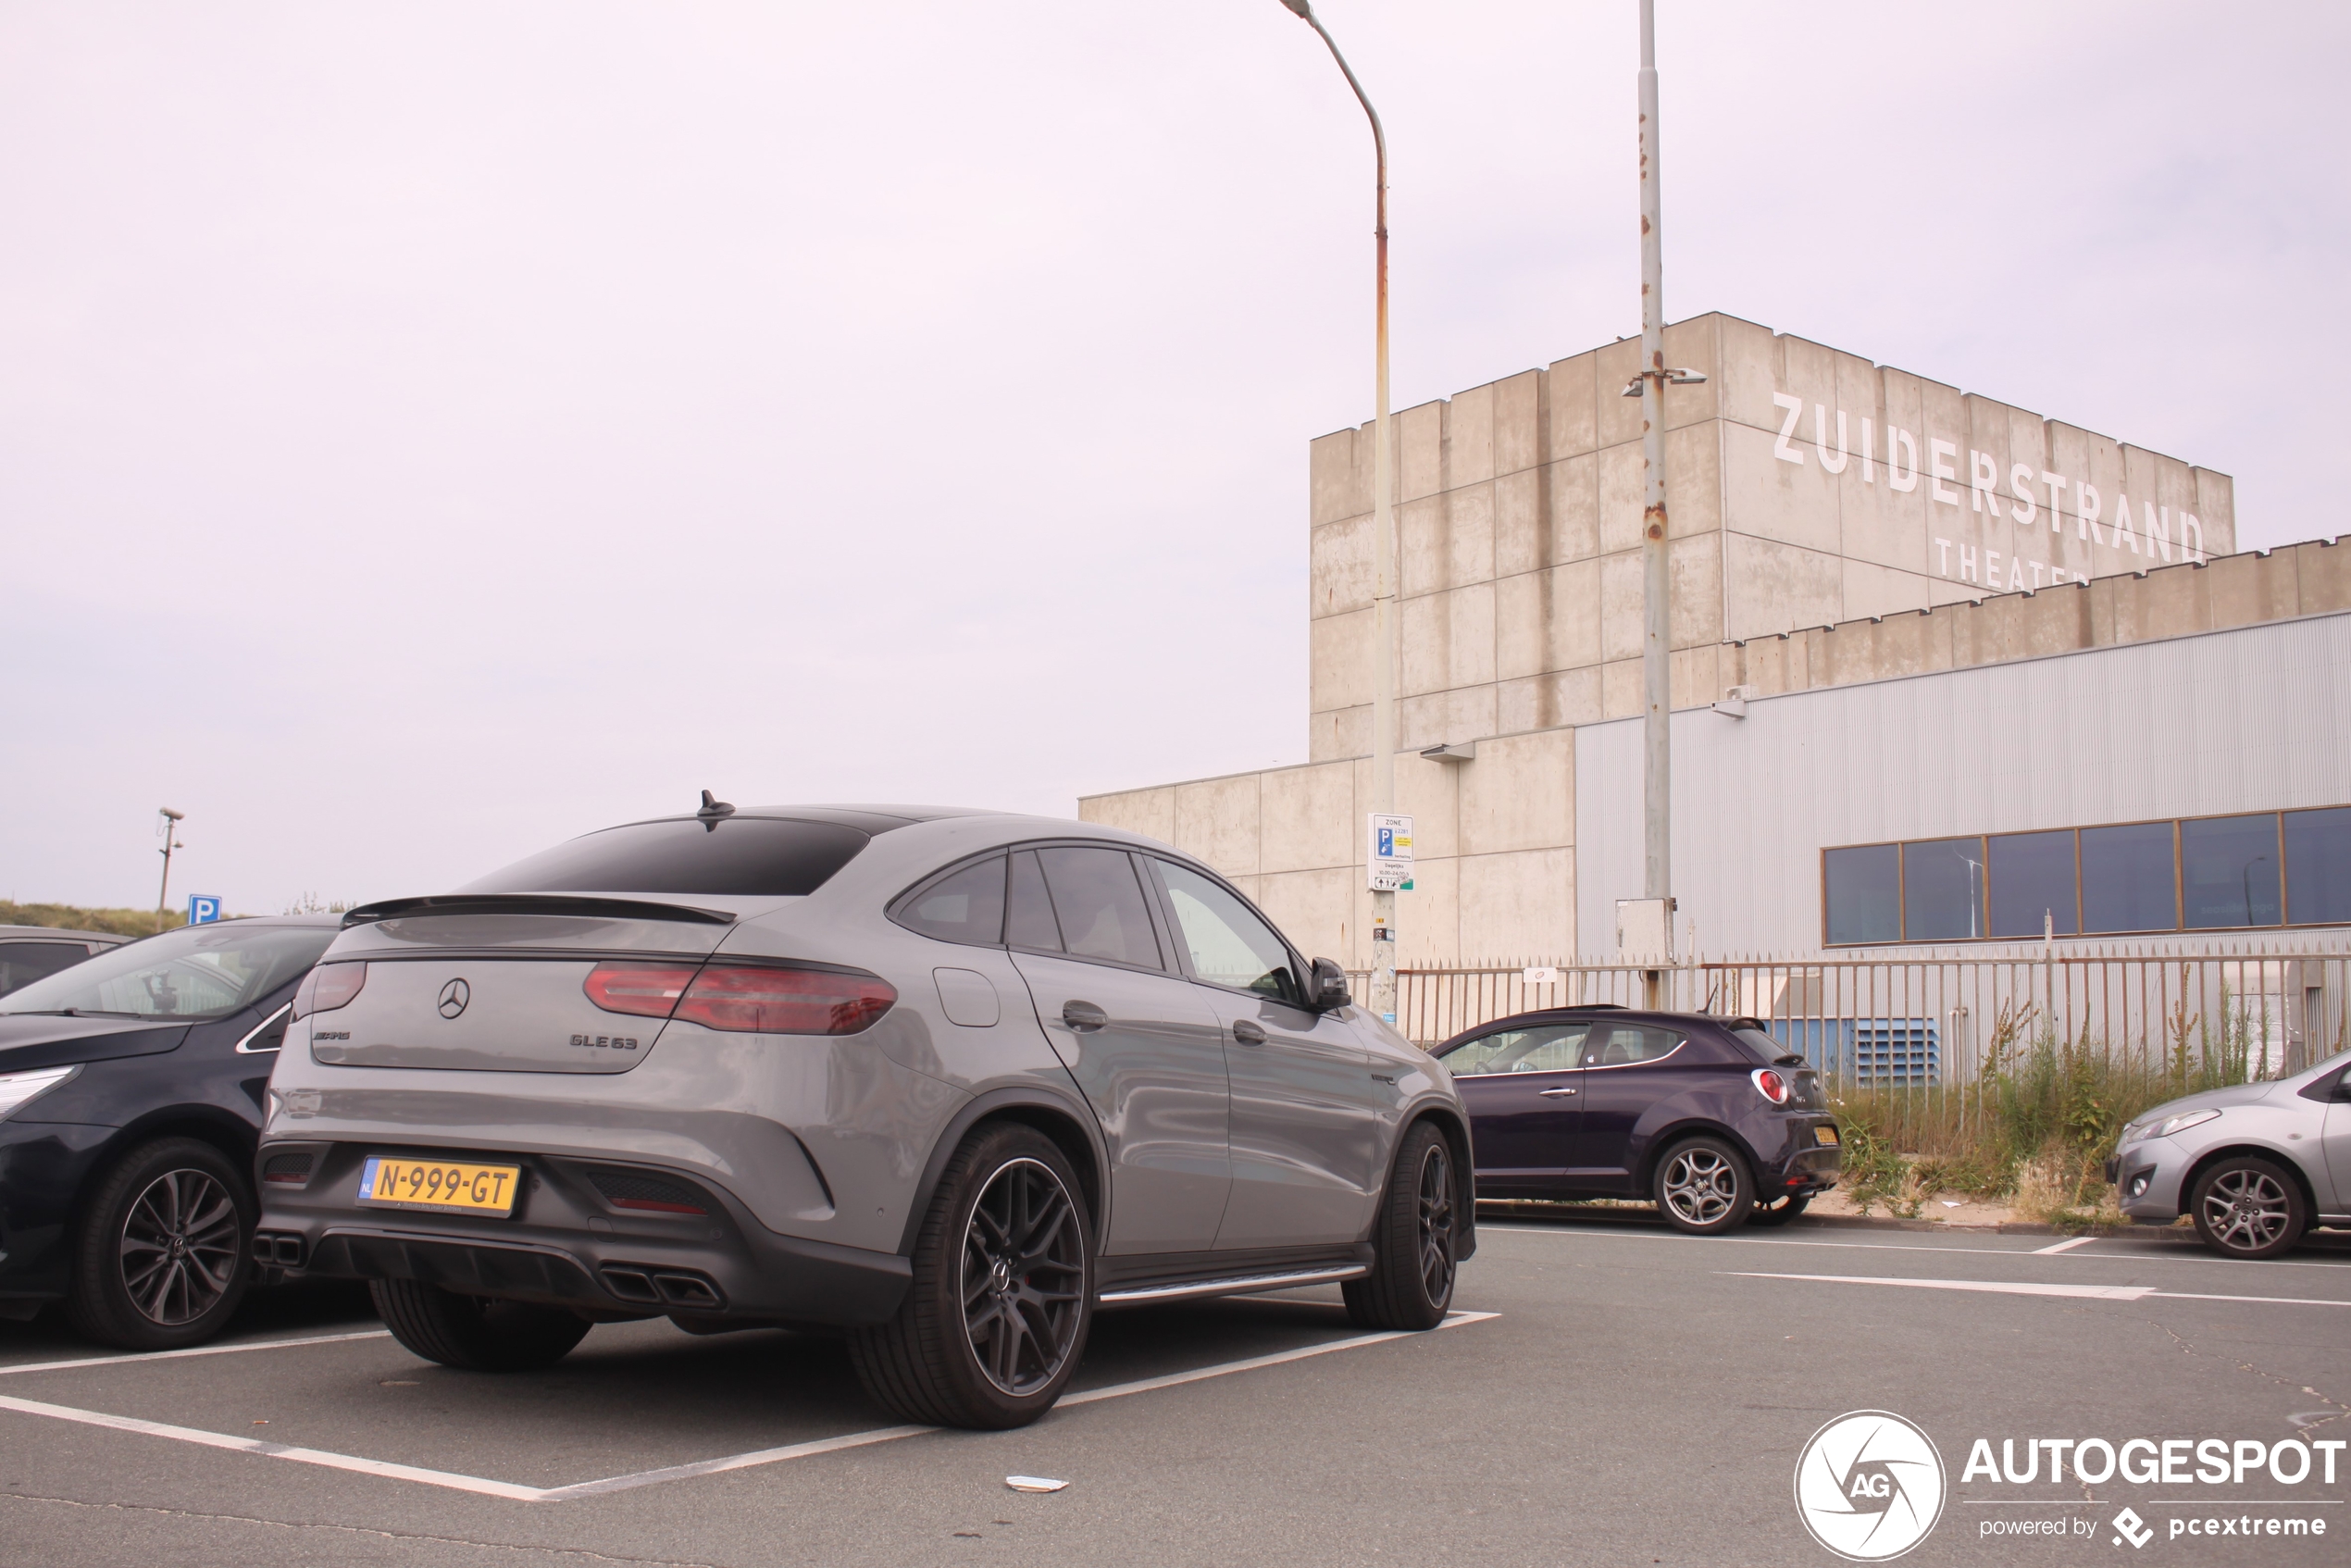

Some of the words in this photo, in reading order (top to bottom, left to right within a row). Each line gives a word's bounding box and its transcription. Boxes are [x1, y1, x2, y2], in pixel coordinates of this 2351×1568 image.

[1773, 391, 2205, 565] ZUIDERSTRAND
[1382, 829, 1390, 843] P
[196, 900, 215, 924] P
[569, 1034, 609, 1048] GLE
[611, 1037, 639, 1050] 63
[361, 1183, 371, 1193] NL
[379, 1164, 509, 1204] N-999-GT
